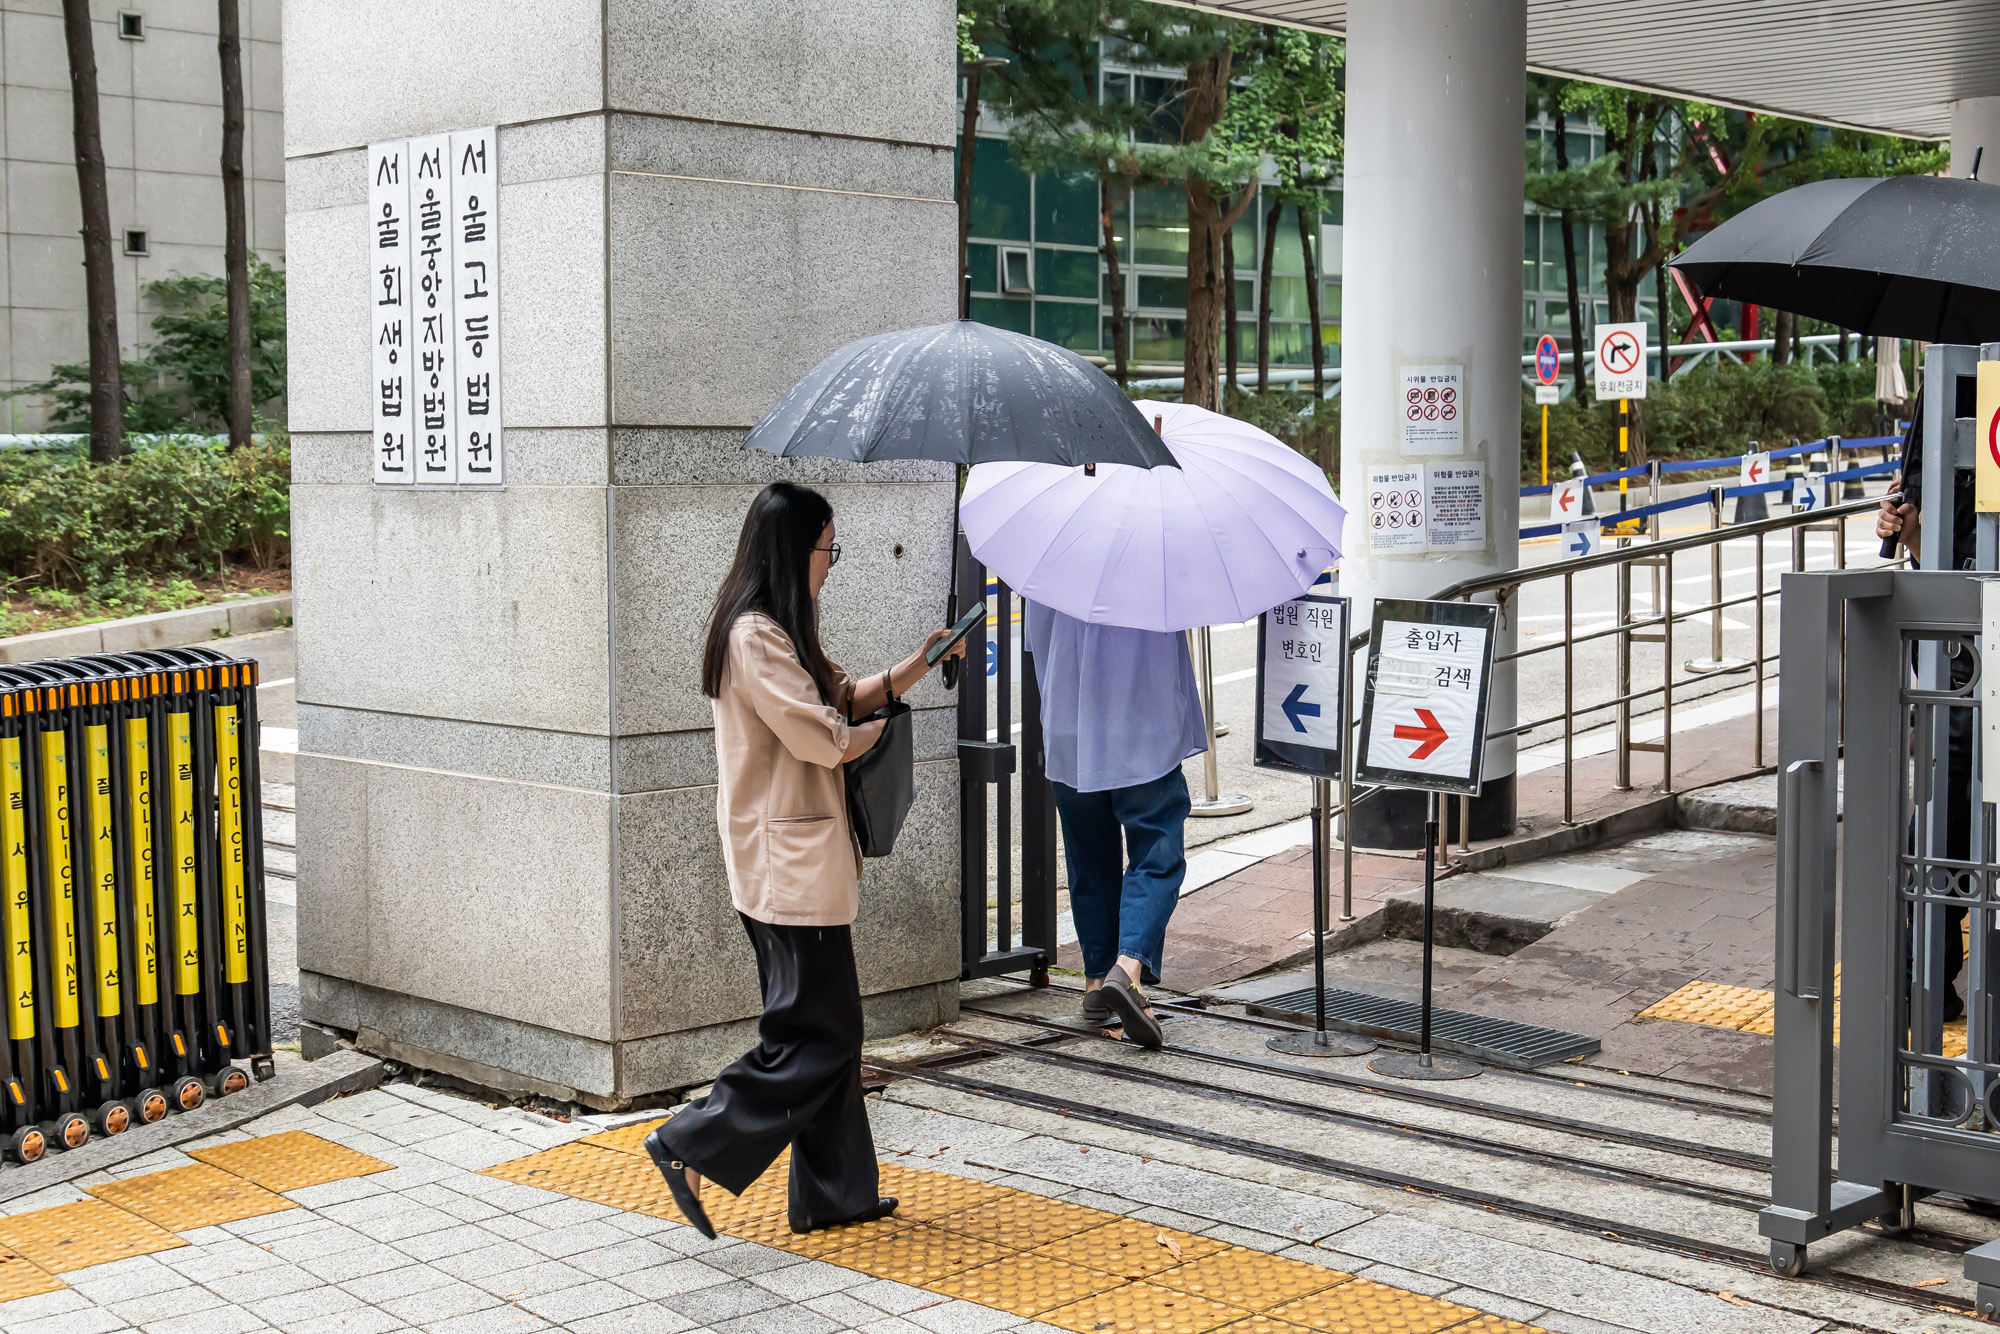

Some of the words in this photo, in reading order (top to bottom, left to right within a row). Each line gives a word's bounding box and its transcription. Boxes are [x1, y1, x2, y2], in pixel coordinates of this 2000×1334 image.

[377, 153, 404, 473] 서울회생법원
[418, 147, 447, 473] 서울중앙지방법원
[461, 139, 492, 474] 서울고등법원
[1430, 375, 1457, 383] 반입금지
[1600, 380, 1642, 393] 우회전금지
[1373, 474, 1390, 483] 위험물
[1391, 473, 1417, 482] 반입금지
[1433, 470, 1453, 479] 위험물
[1455, 470, 1480, 478] 반입금지
[1273, 604, 1298, 626] 법원
[1306, 607, 1333, 629] 직원
[1282, 639, 1321, 662] 변호인
[1405, 628, 1462, 654] 출입자
[1434, 666, 1472, 690] 검색
[139, 770, 152, 881] POLICE
[228, 756, 242, 863] POLICE
[235, 884, 245, 954] LINE
[58, 785, 72, 899] POLICE
[66, 922, 76, 996] LINE
[145, 902, 155, 974] LINE
